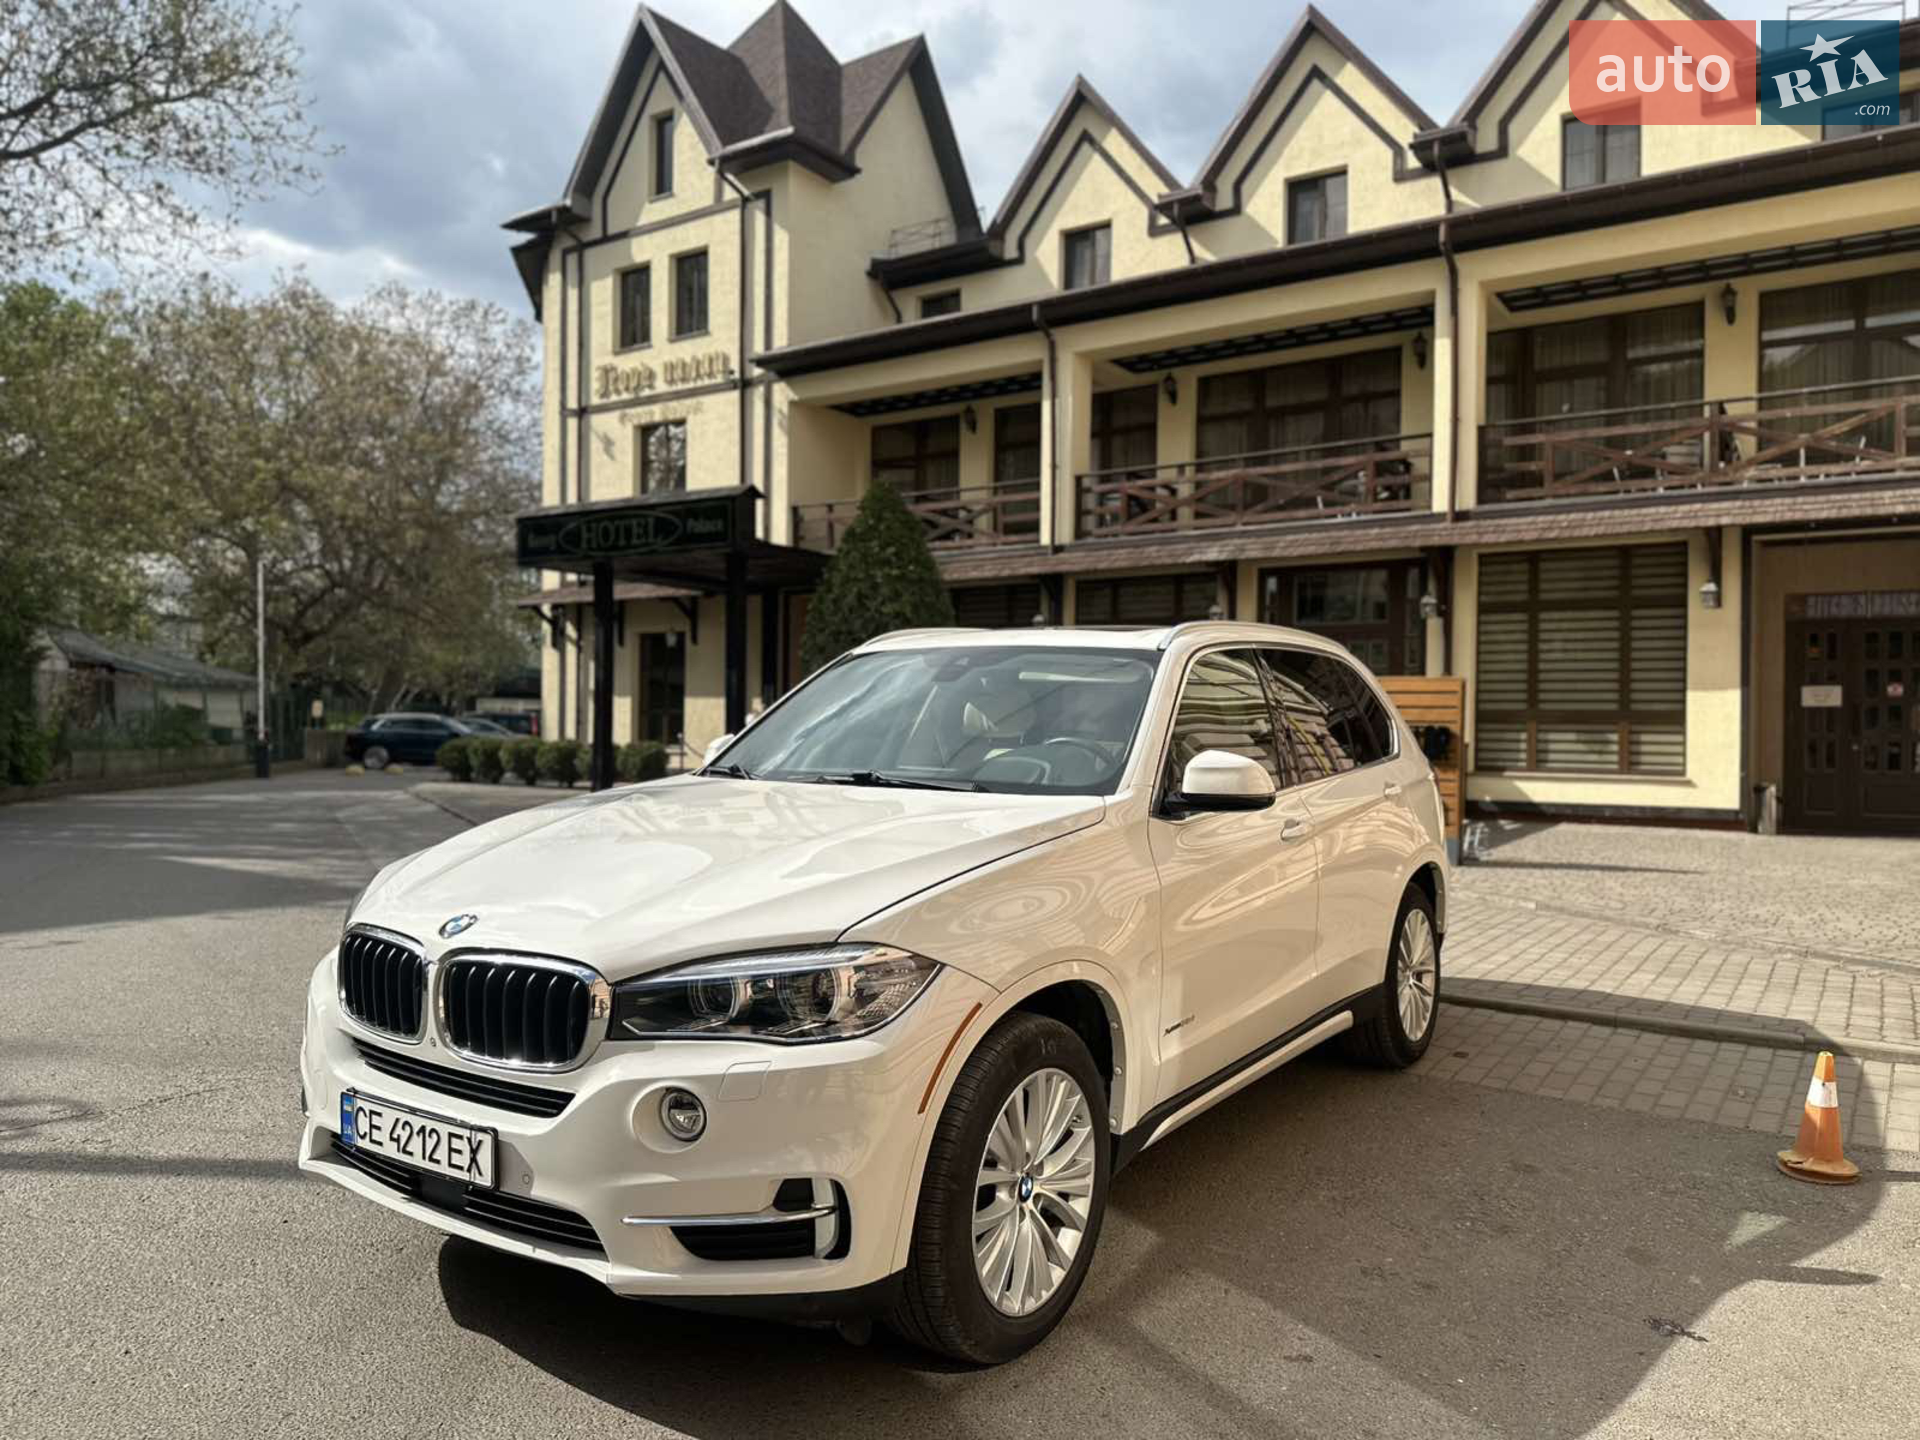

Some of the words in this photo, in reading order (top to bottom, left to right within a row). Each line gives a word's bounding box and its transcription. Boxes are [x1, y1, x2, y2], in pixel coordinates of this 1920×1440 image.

[580, 516, 664, 548] HOTEL
[354, 1105, 384, 1147] CE
[389, 1117, 442, 1165] 4212
[447, 1131, 484, 1177] EX
